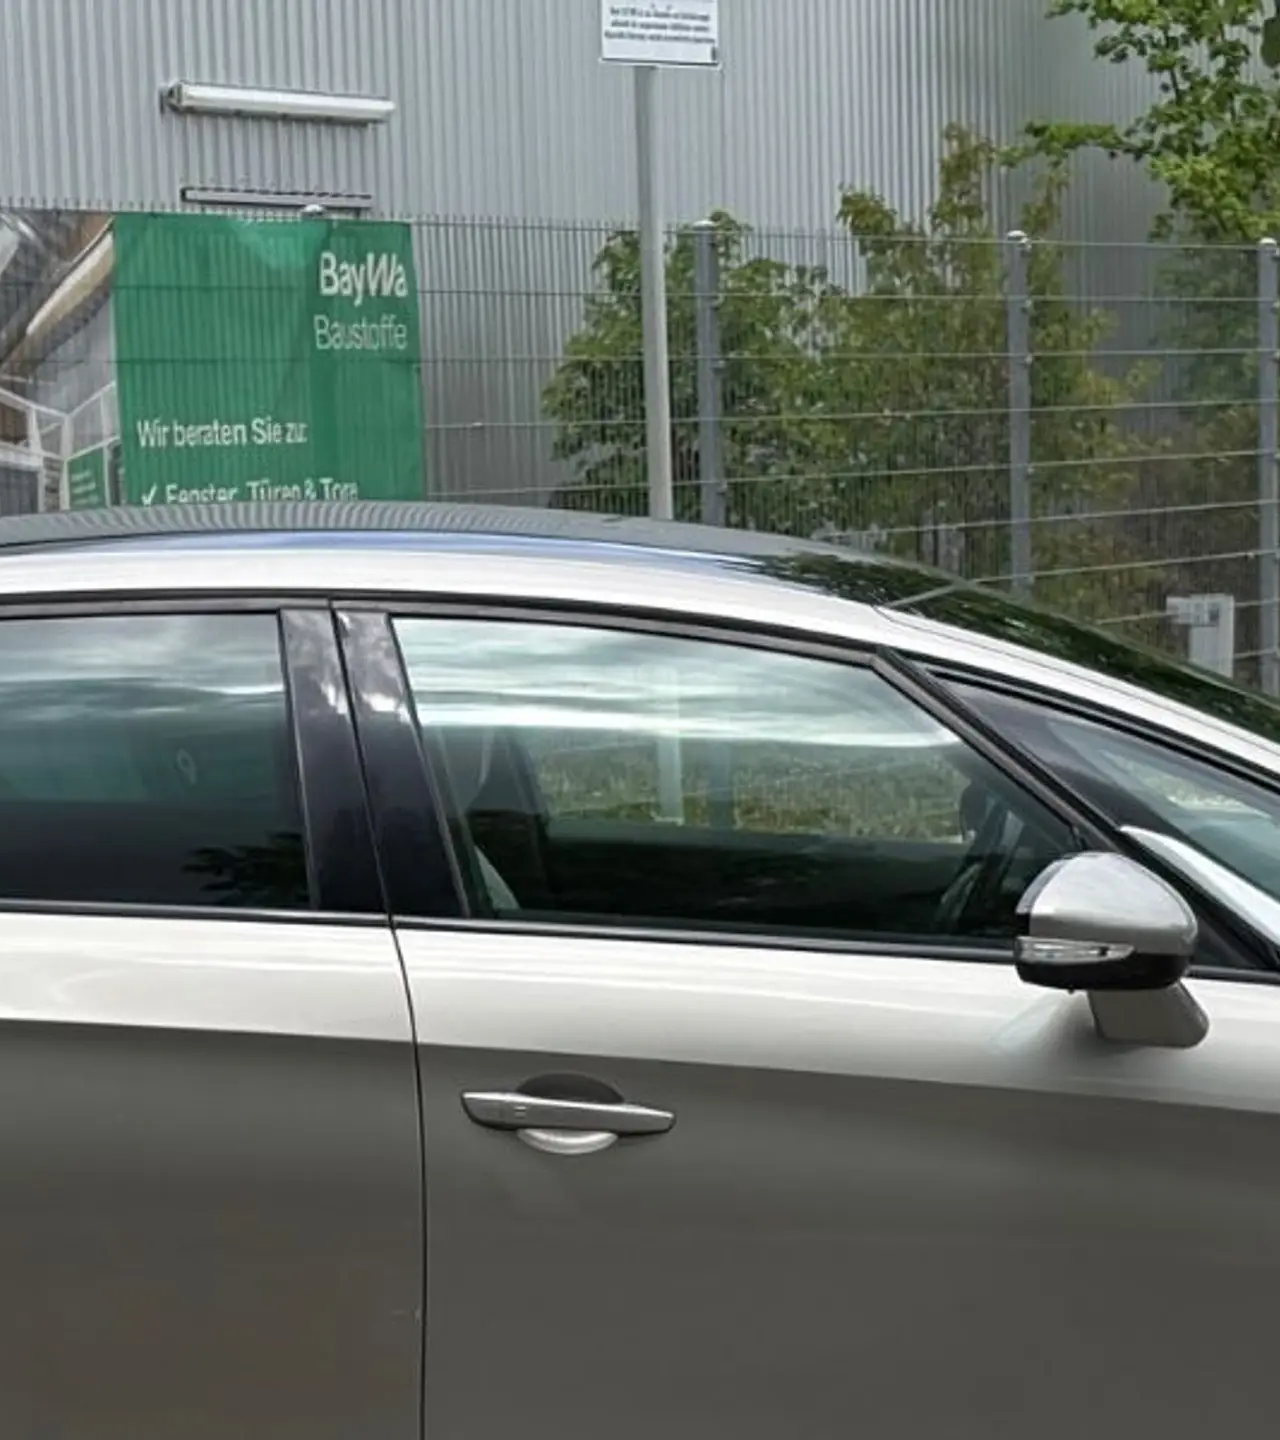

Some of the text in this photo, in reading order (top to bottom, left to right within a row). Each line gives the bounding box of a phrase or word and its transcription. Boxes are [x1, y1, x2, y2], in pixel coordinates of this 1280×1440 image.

[320, 251, 409, 308] BayWa
[313, 314, 408, 350] Baustoffe
[136, 418, 170, 448] Wir
[172, 419, 247, 446] beraten
[251, 416, 283, 445] Sie
[303, 477, 317, 501] &
